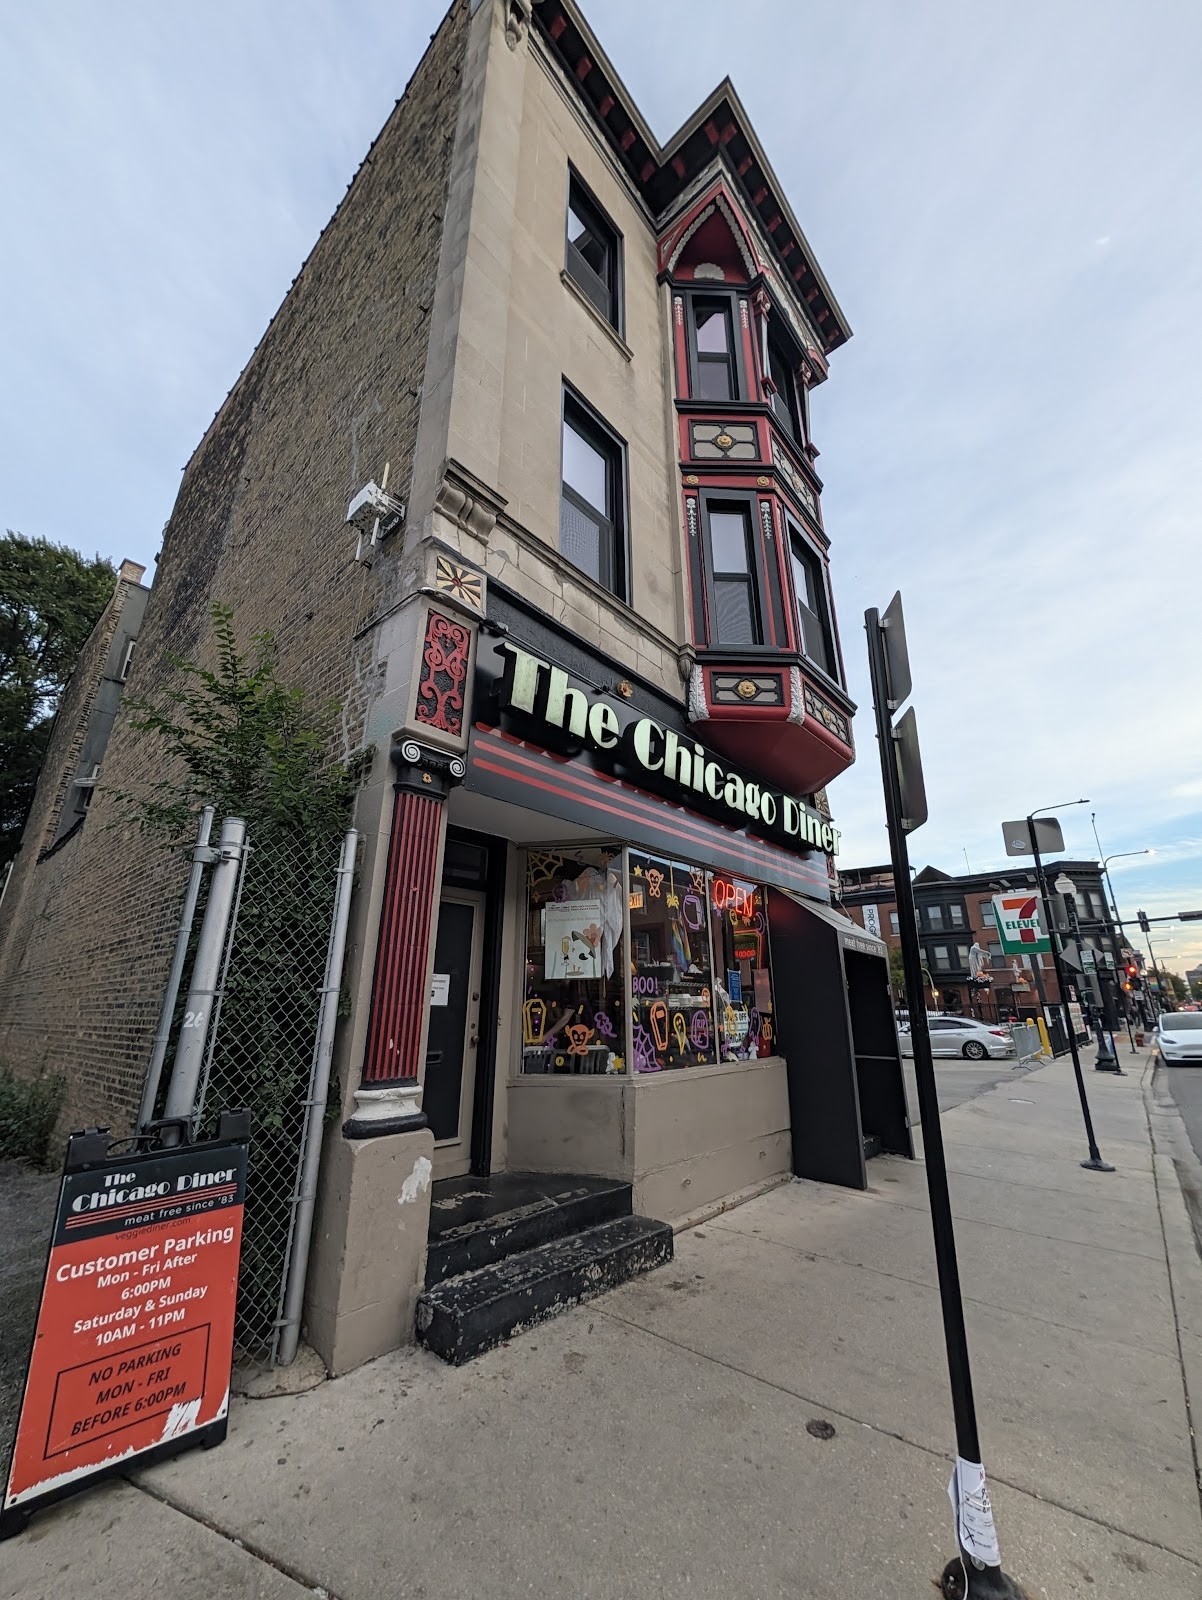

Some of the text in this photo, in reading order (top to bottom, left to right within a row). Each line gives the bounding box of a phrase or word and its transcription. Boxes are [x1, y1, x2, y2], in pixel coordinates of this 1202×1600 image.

[502, 641, 842, 856] The Chicago Diner
[714, 879, 753, 917] OPEN
[1001, 896, 1038, 943] 7
[844, 937, 856, 947] meat
[857, 938, 866, 950] free
[632, 976, 659, 995] BOO!
[696, 1018, 706, 1028] RIP
[72, 1167, 237, 1214] Chicago Diner
[104, 1170, 136, 1187] The
[115, 1216, 190, 1241] veggiediner.com
[125, 1194, 234, 1226] meat free since '83
[56, 1225, 234, 1282] Customer Parking
[97, 1271, 127, 1288] Mon
[142, 1260, 161, 1275] Fri
[163, 1252, 197, 1272] After
[121, 1276, 171, 1300] 6:00PM
[73, 1284, 208, 1334] Saturday & Sunday
[95, 1328, 135, 1347] 10AM
[148, 1308, 186, 1331] 11PM
[88, 1343, 182, 1387] NO PARKING
[96, 1382, 133, 1405] MON
[146, 1367, 171, 1390] FRI
[71, 1381, 187, 1436] BEFORE 6:00PM
